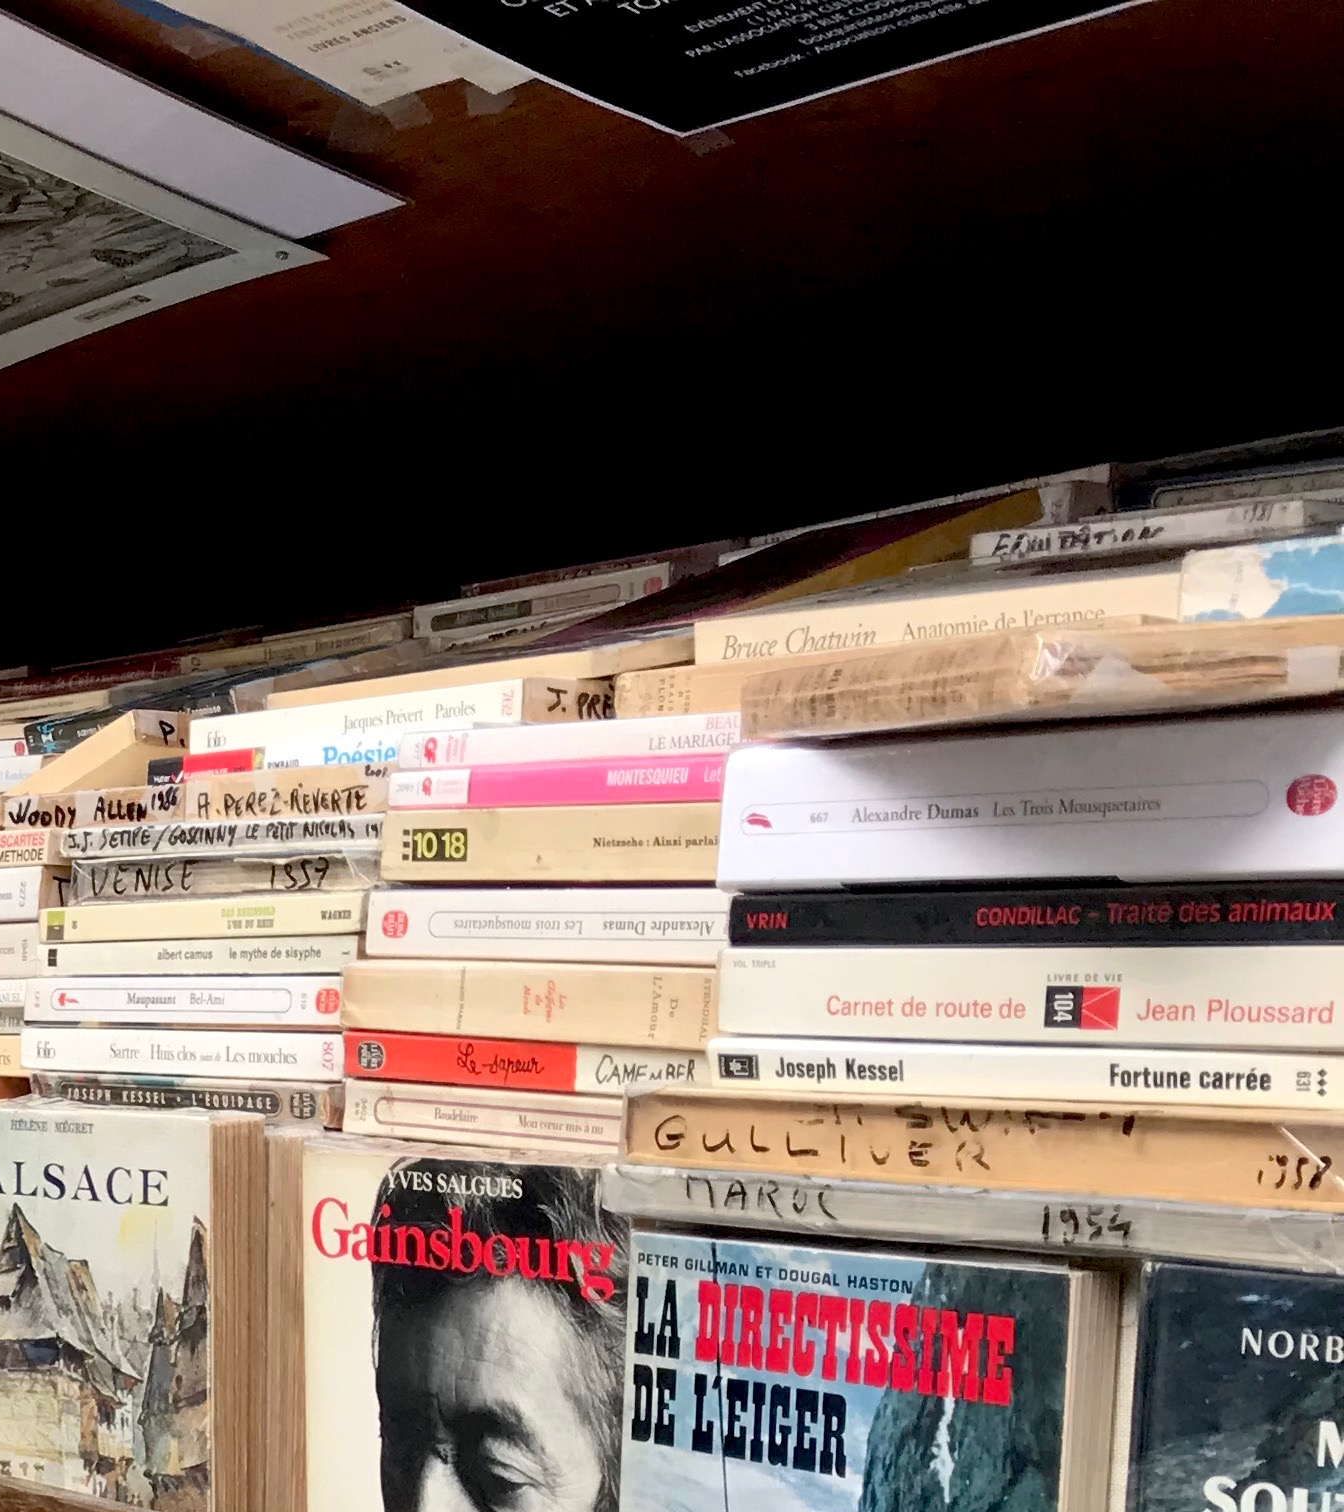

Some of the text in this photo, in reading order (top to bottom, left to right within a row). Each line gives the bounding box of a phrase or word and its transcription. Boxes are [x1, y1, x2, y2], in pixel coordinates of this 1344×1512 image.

[722, 604, 1106, 660] Bruce Chatwin Anatomie de l'errance
[343, 703, 476, 735] Jacques Prévert Paroles
[323, 740, 397, 766] Poésie
[649, 732, 736, 751] LE MARIAGE
[606, 765, 690, 788] MONTESQUIEU
[809, 796, 1162, 824] 667 Alexandre Dumas Les Trois Mousquetaires
[90, 859, 202, 897] VENISE
[452, 917, 716, 938] Alexandre Dumas Les trois mousquetaires
[745, 899, 1336, 931] VRIN CONDILLAC Traité des animaux
[157, 947, 183, 961] albert
[184, 949, 213, 961] camus
[239, 947, 269, 962] mythe
[270, 946, 282, 959] de
[284, 945, 322, 962] sisyphe
[1046, 973, 1124, 983] LIVRE DE VIE
[126, 991, 225, 1008] Maupassant Bel-Ami
[825, 995, 1335, 1026] Carnet de route de Jean Ploussard
[1052, 991, 1075, 1024] 104
[774, 1056, 1312, 1093] Joseph Kessel Fortune carrée 631
[66, 1085, 273, 1111] JOSEPH KESSEL L'ÉQUIPAGE
[655, 1112, 991, 1172] GULLIVER
[386, 1169, 524, 1200] YVES SALGUES
[686, 1175, 836, 1222] MAROC
[311, 1195, 615, 1303] Gainsbourg
[636, 1250, 914, 1295] PETER GILLMAN ET DOUGAL HASTON
[634, 1275, 1015, 1408] LA DIRECTISSIME
[630, 1364, 849, 1480] DE L'EIGER
